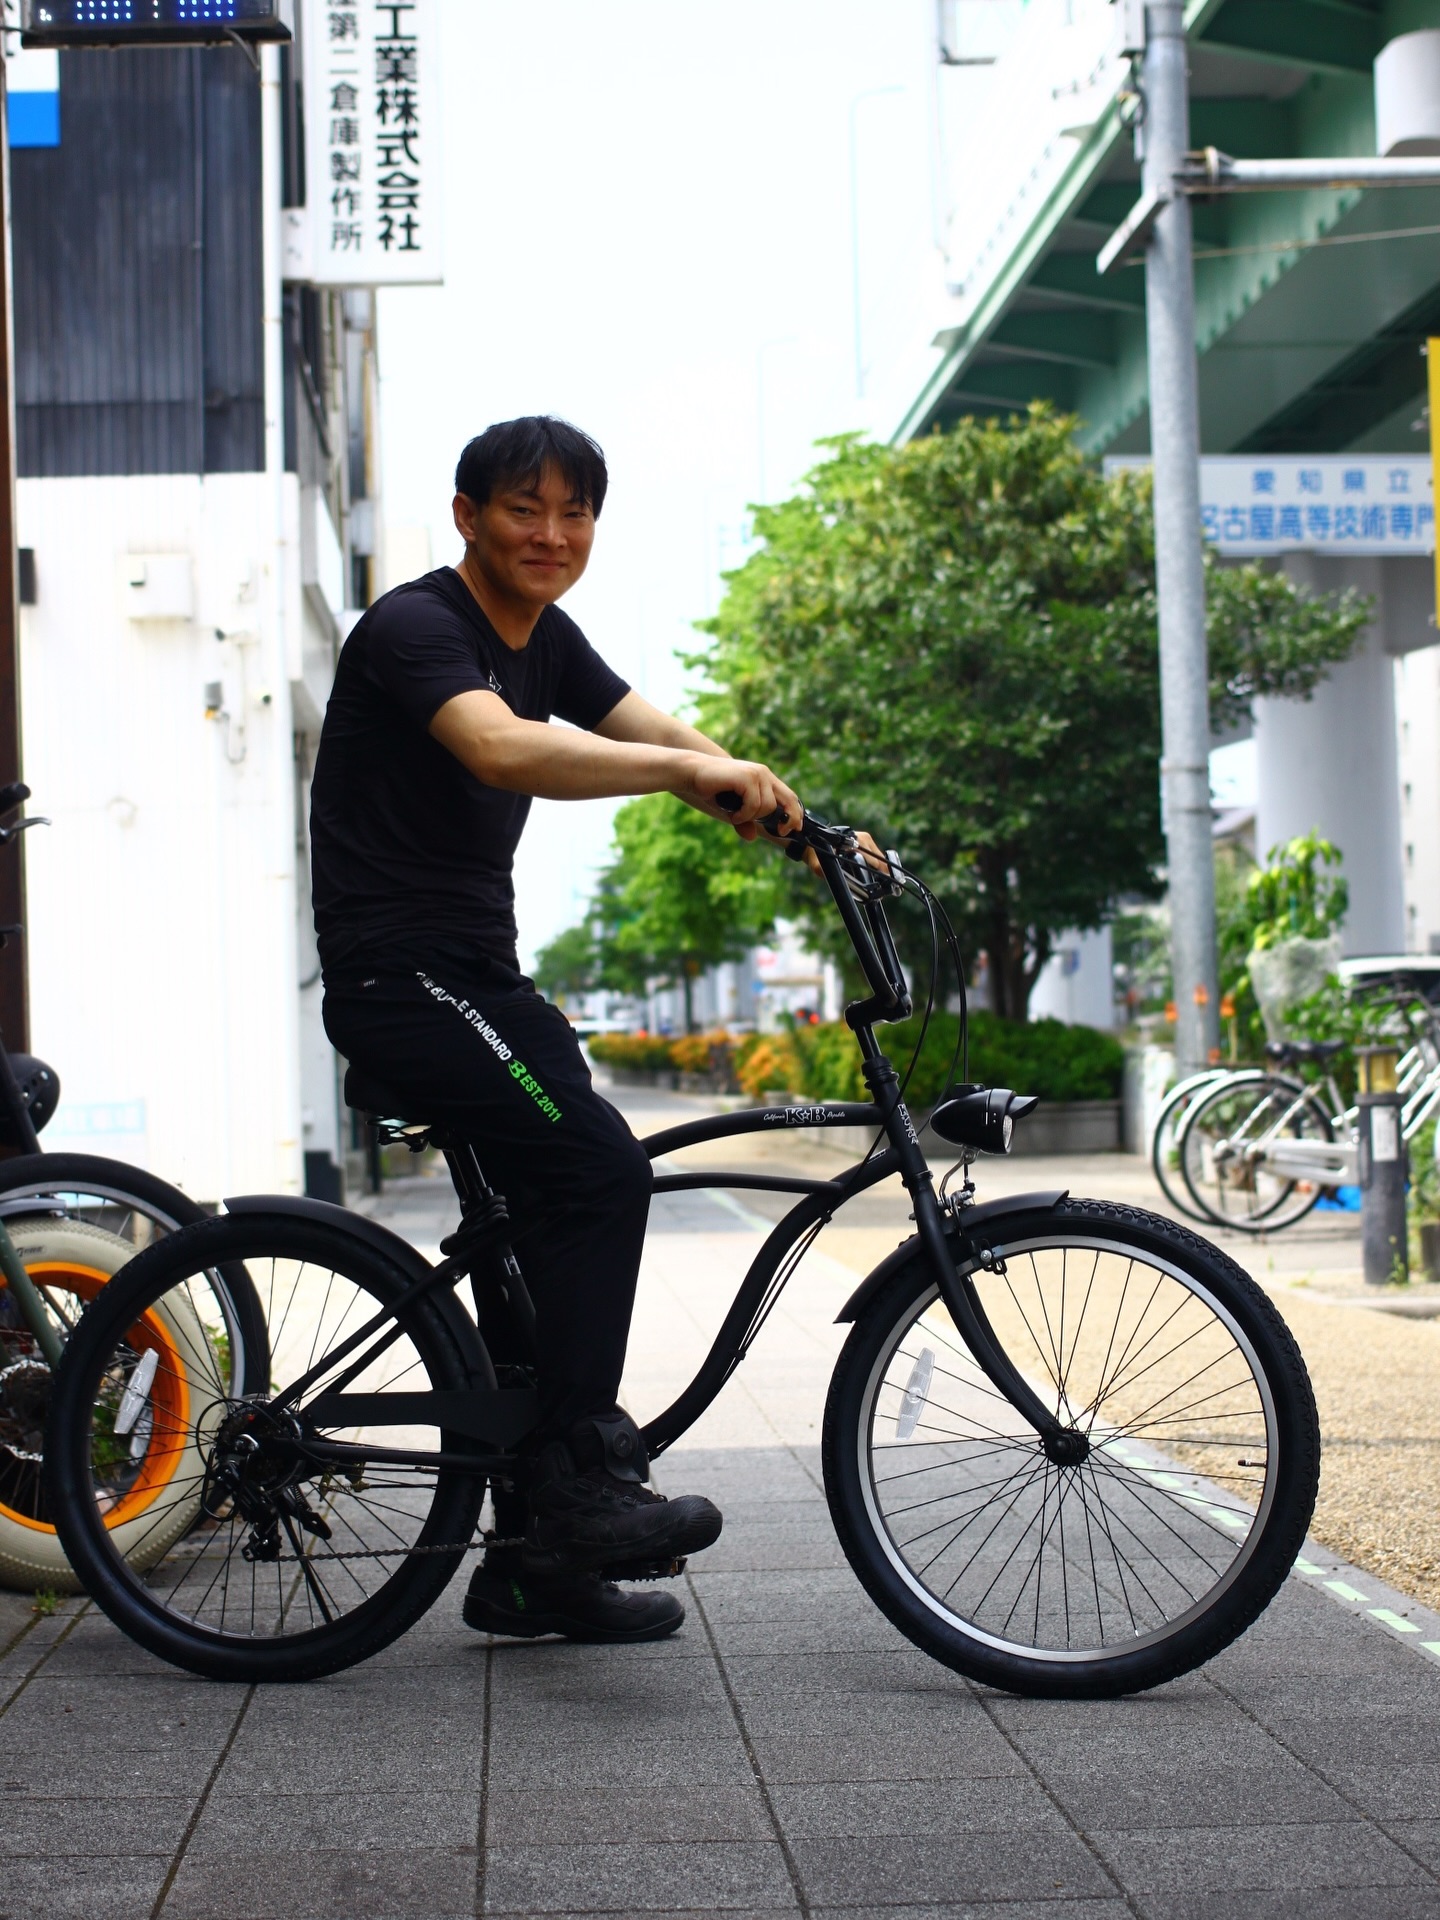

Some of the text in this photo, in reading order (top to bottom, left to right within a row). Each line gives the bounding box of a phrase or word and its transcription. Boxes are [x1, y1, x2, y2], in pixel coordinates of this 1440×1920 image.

[327, 0, 362, 250] 第二倉庫製作所
[375, 0, 420, 251] 工業株式会社
[465, 1009, 512, 1061] STANDARD
